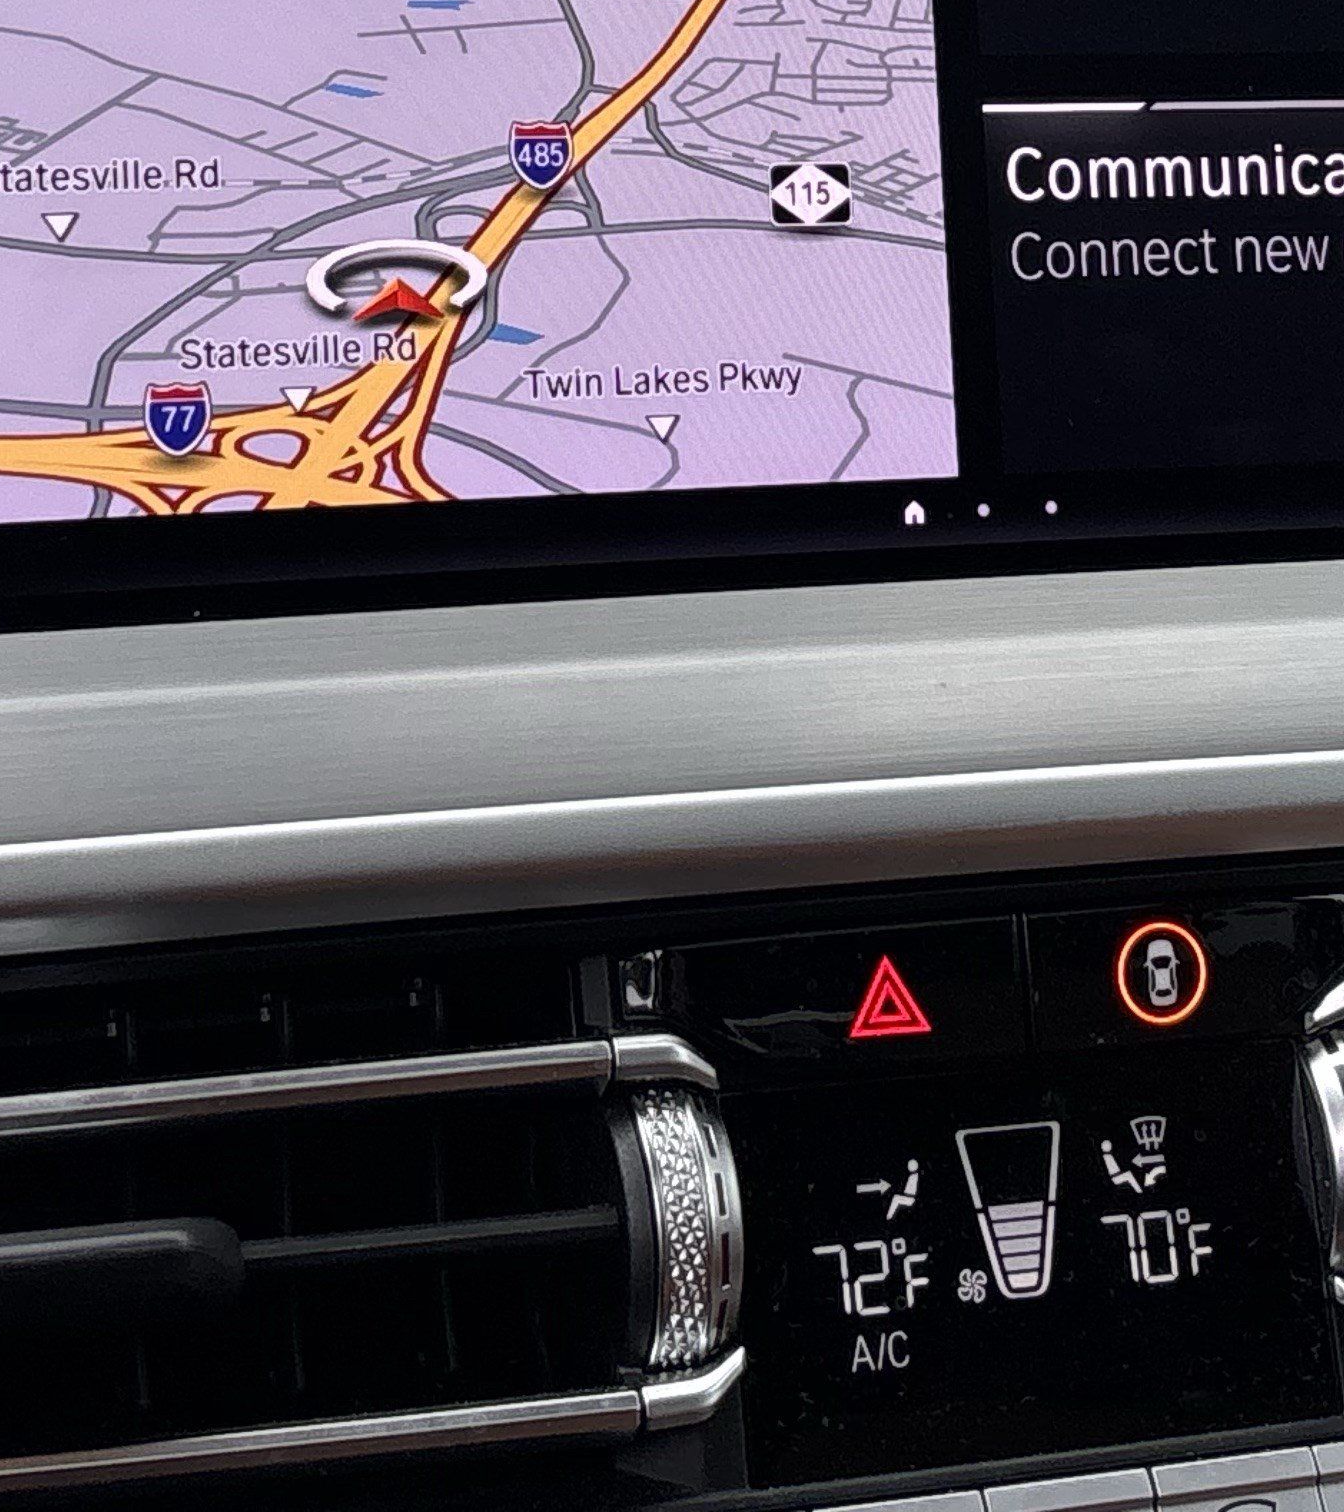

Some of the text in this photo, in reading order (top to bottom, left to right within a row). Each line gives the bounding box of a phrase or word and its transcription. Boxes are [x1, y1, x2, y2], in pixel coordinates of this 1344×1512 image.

[517, 142, 565, 169] 485
[174, 160, 220, 189] Rd
[783, 180, 831, 207] 115
[1010, 228, 1217, 281] Connect
[1234, 234, 1329, 272] new
[180, 334, 417, 370] Statesville Rd
[524, 365, 803, 399] Twin Lakes Pkwy
[161, 406, 194, 433] 77
[852, 1330, 911, 1373] A/C
